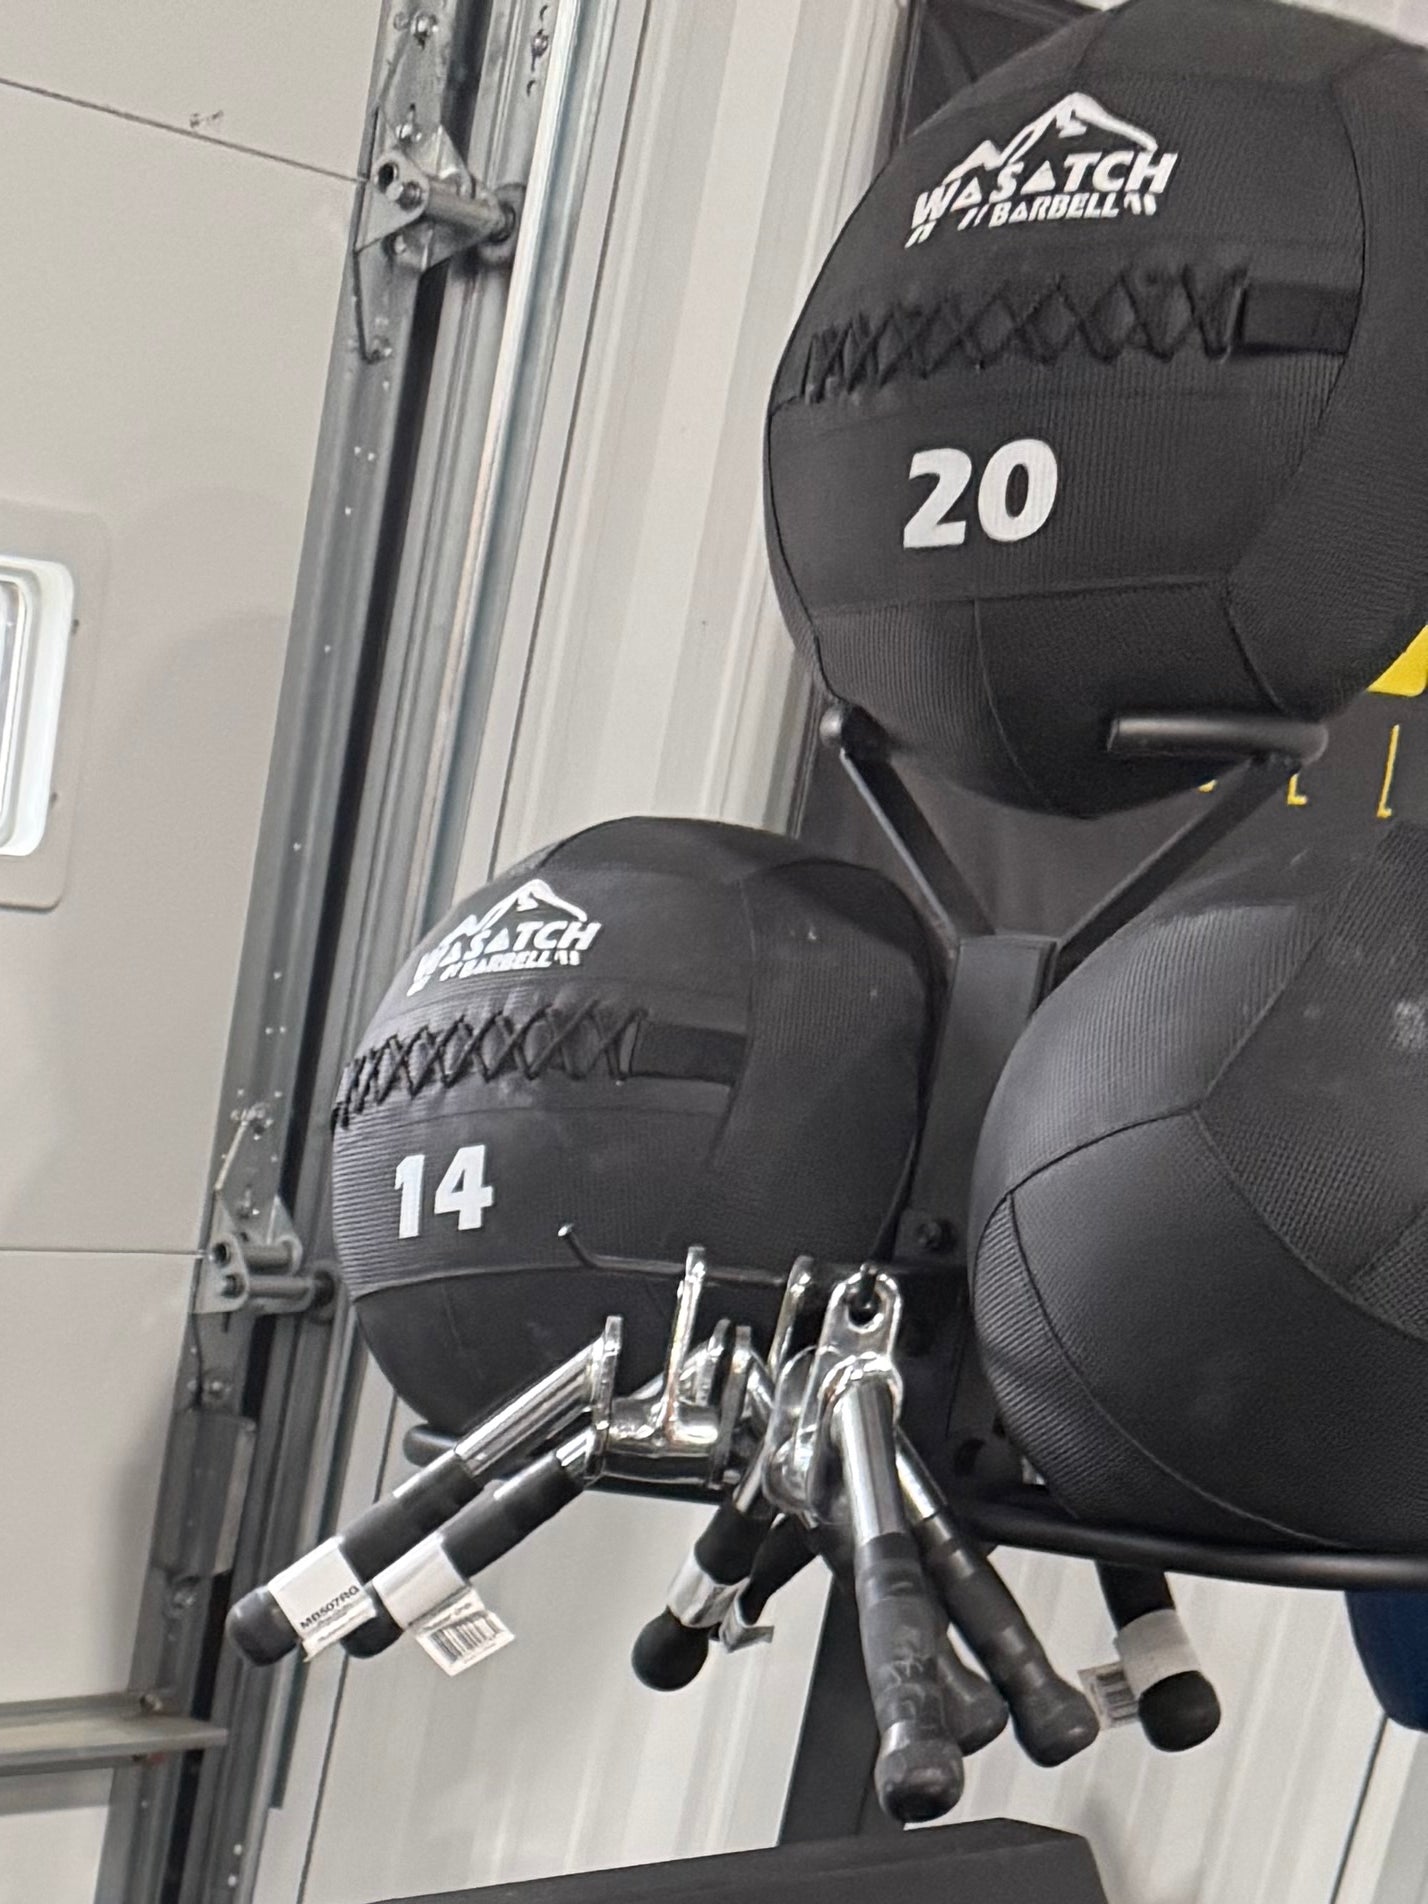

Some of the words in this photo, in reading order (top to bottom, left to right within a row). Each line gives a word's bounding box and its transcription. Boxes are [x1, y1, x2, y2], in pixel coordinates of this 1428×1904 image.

[909, 151, 1179, 230] WASATCH
[988, 191, 1120, 229] BARBELL
[902, 439, 1058, 548] 20
[412, 920, 603, 983] WASATCH
[394, 1144, 494, 1240] 14
